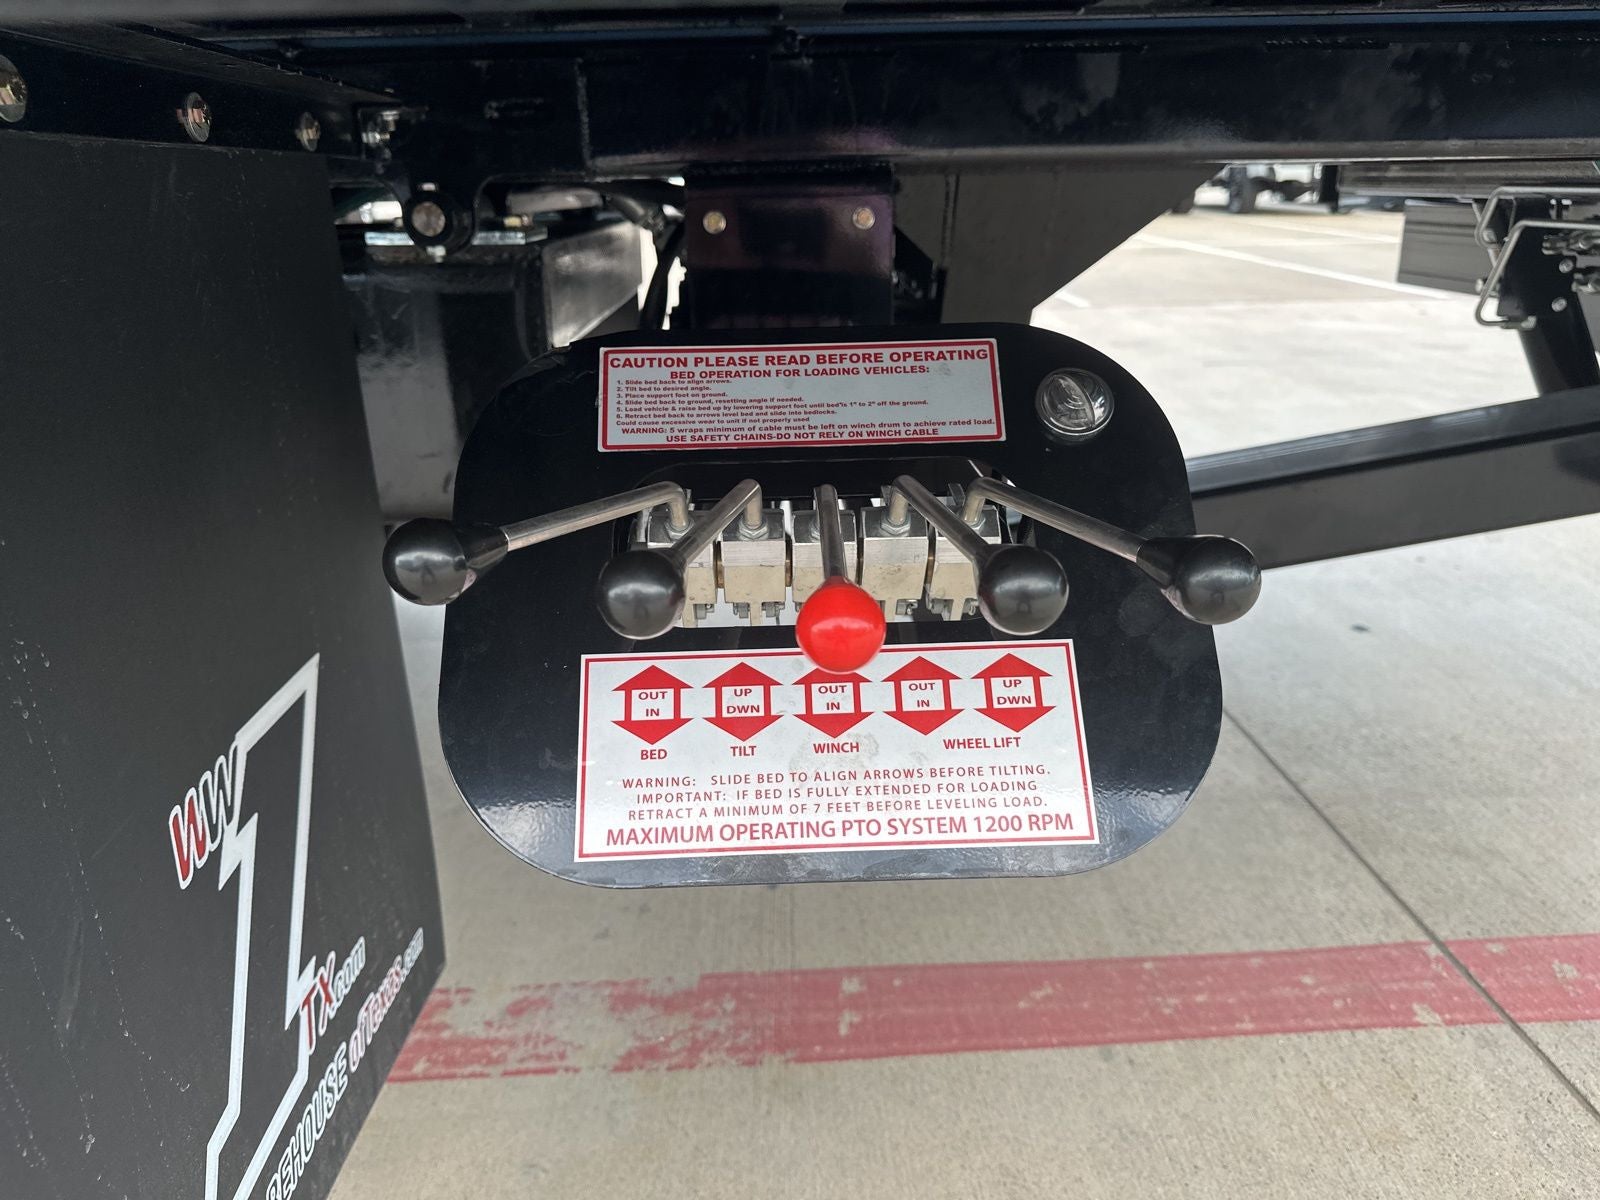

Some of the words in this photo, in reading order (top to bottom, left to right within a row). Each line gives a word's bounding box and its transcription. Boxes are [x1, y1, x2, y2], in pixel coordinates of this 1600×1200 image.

[609, 357, 687, 368] CAUTION
[694, 355, 759, 367] PLEASE
[764, 354, 810, 365] READ
[816, 352, 883, 364] BEFORE
[889, 348, 987, 362] OPERATING
[670, 371, 695, 379] BED
[699, 369, 771, 378] OPERATION
[775, 368, 800, 377] FOR
[804, 367, 860, 376] LOADING
[863, 365, 929, 374] VEHICLES:
[733, 432, 791, 440] CHAINS-DO
[794, 431, 815, 439] NOT
[865, 429, 901, 437] WINCH
[904, 428, 938, 436] CABLE
[908, 682, 935, 691] OUT
[1002, 679, 1022, 688] UP
[638, 688, 667, 698] OUT
[733, 688, 752, 697] UP
[817, 685, 846, 694] OUT
[916, 699, 930, 707] IN
[996, 695, 1031, 704] DWN
[726, 704, 759, 713] DWN
[826, 702, 840, 710] IN
[645, 708, 659, 716] IN
[813, 741, 859, 753] WINCH
[942, 737, 991, 749] WHEEL
[993, 736, 1021, 748] LIFT
[640, 748, 667, 760] BED
[729, 745, 756, 756] TILT
[622, 776, 695, 788] WARNING:
[710, 773, 751, 785] SLIDE
[757, 772, 784, 783] BED
[789, 772, 807, 782] TO
[813, 770, 856, 781] ALIGN
[863, 768, 924, 779] ARROWS
[929, 766, 984, 777] BEFORE
[988, 764, 1050, 775] TILTING.
[637, 790, 725, 804] IMPORTANT:
[736, 789, 748, 800] IF
[754, 788, 782, 799] BED
[788, 787, 800, 798] IS
[807, 786, 849, 797] FULLY
[855, 783, 931, 796] EXTENDED
[937, 782, 965, 793] FOR
[970, 780, 1037, 792] LOADING
[628, 807, 692, 820] RETRACT
[698, 807, 707, 817] A
[714, 804, 782, 816] MINIMUM
[789, 803, 807, 814] OF
[813, 803, 820, 813] 7
[827, 801, 860, 812] FEET
[866, 799, 921, 811] BEFORE
[927, 797, 997, 809] LEVELING
[1003, 796, 1047, 807] LOAD.
[606, 824, 713, 846] MAXIMUM
[719, 820, 835, 841] OPERATING
[841, 818, 881, 836] PTO
[887, 816, 967, 835] SYSTEM
[973, 815, 1022, 832] 1200
[1027, 813, 1073, 830] RPM
